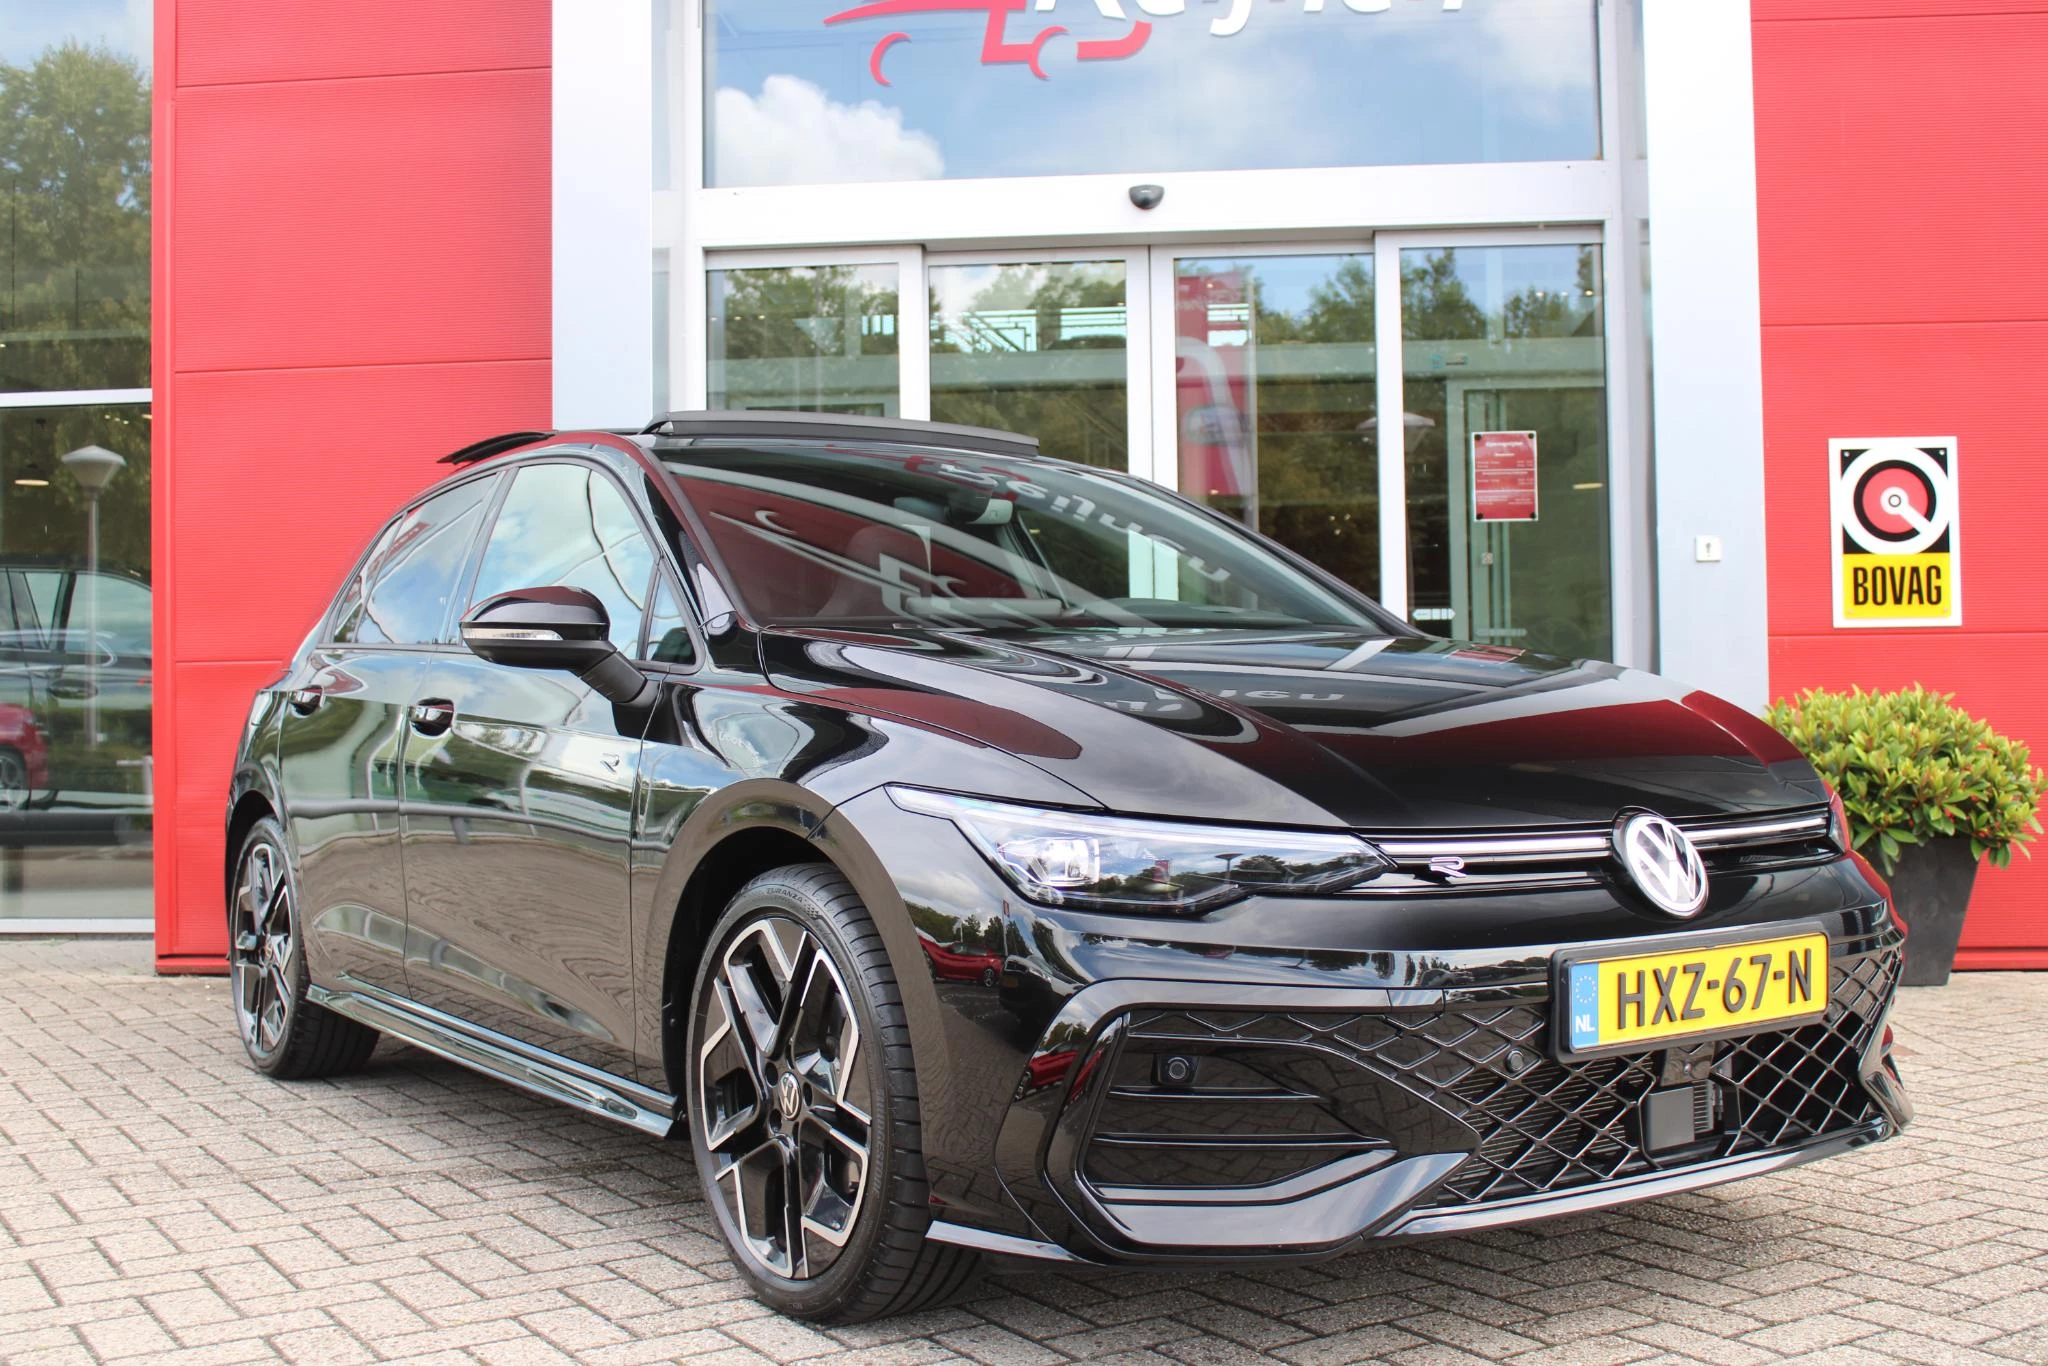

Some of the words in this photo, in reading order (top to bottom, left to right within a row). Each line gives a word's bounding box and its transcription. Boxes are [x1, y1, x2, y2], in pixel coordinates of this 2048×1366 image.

[1853, 565, 1942, 606] BOVAG
[1429, 856, 1468, 879] R
[1618, 948, 1812, 1030] HXZ-67-N
[1575, 1015, 1596, 1034] NL
